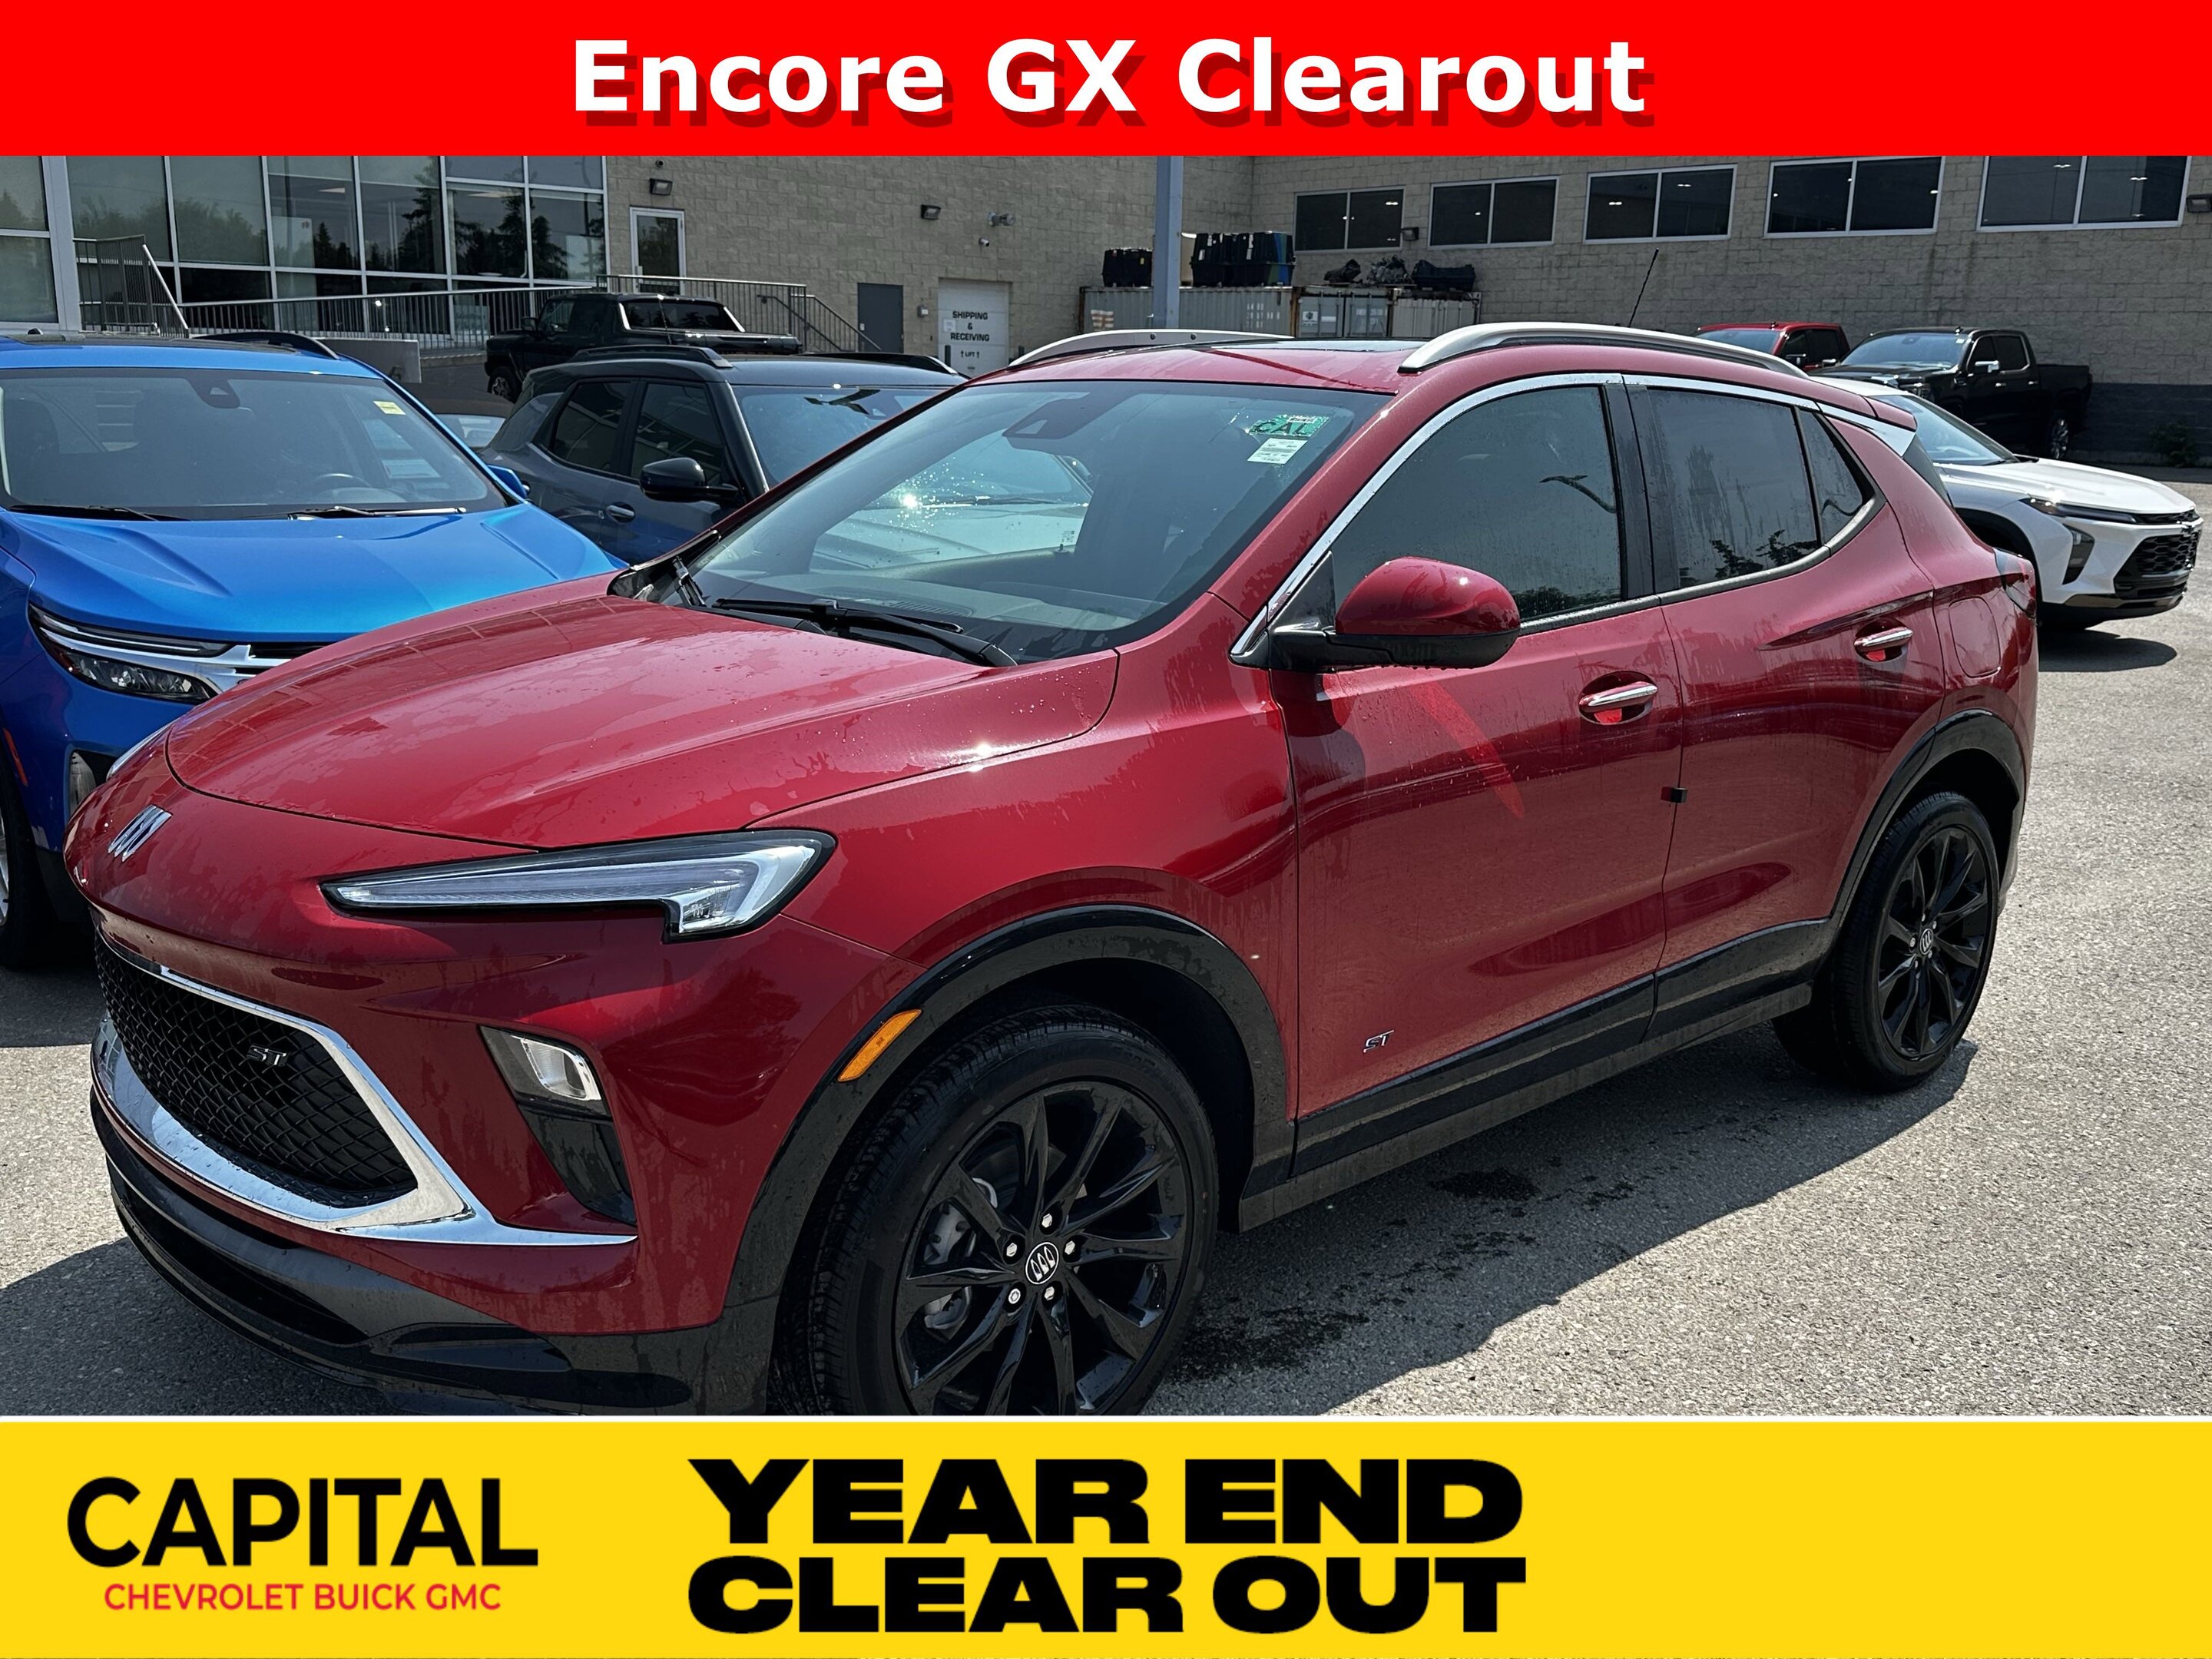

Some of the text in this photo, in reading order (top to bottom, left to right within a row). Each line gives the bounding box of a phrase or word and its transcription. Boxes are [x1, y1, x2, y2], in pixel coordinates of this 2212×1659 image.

[952, 311, 988, 320] SHIPPING
[951, 333, 989, 342] RECEIVING
[1363, 1029, 1394, 1053] ST
[247, 1045, 286, 1065] ST
